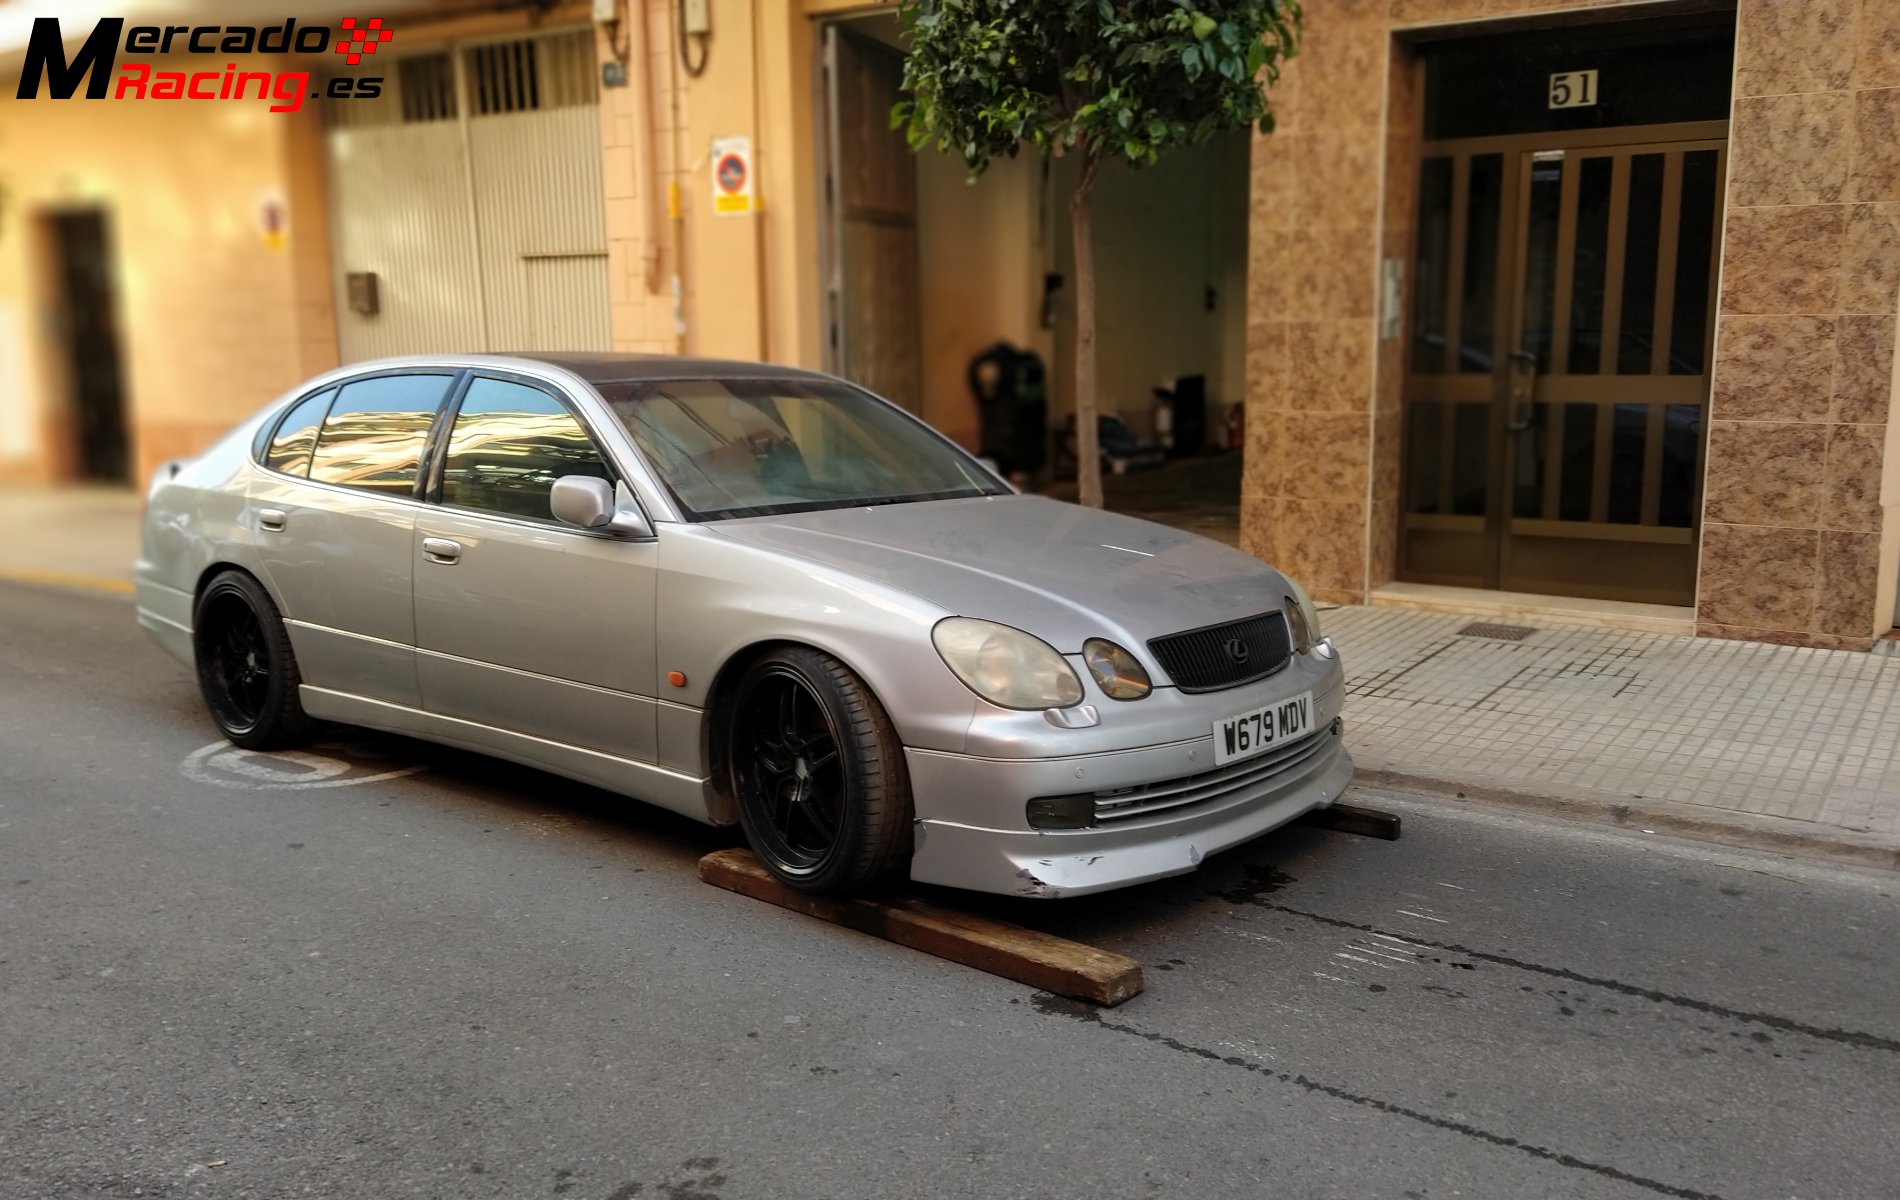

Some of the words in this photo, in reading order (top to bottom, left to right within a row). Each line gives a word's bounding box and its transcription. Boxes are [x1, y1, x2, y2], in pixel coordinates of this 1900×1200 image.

[1552, 73, 1590, 105] 51
[1224, 710, 1274, 755] W679
[1278, 697, 1307, 738] MDV
